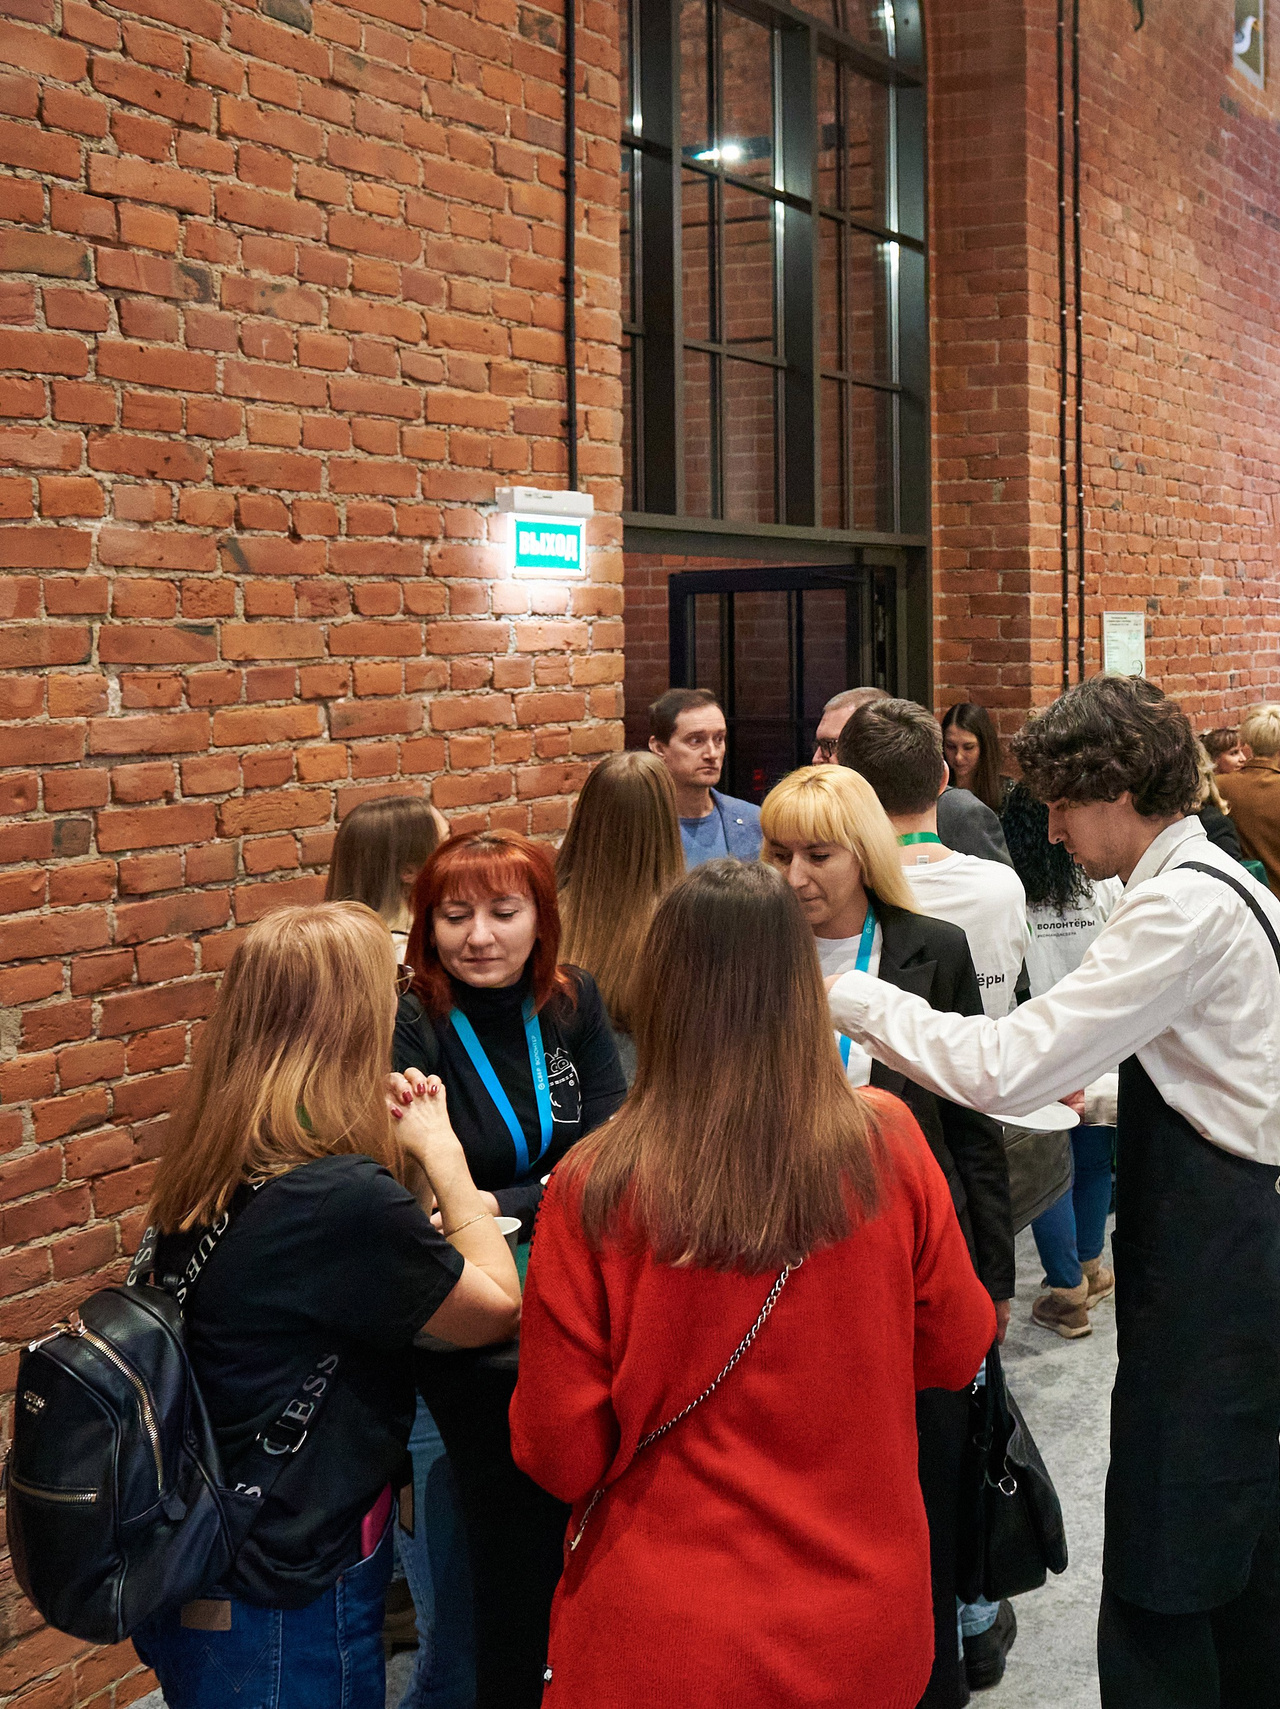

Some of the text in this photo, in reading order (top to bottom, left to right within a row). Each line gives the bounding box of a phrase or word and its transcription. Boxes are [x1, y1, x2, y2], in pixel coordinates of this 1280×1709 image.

[519, 530, 578, 562] ВЫХОД
[1037, 918, 1095, 930] волонтёры
[976, 973, 1005, 989] ёры
